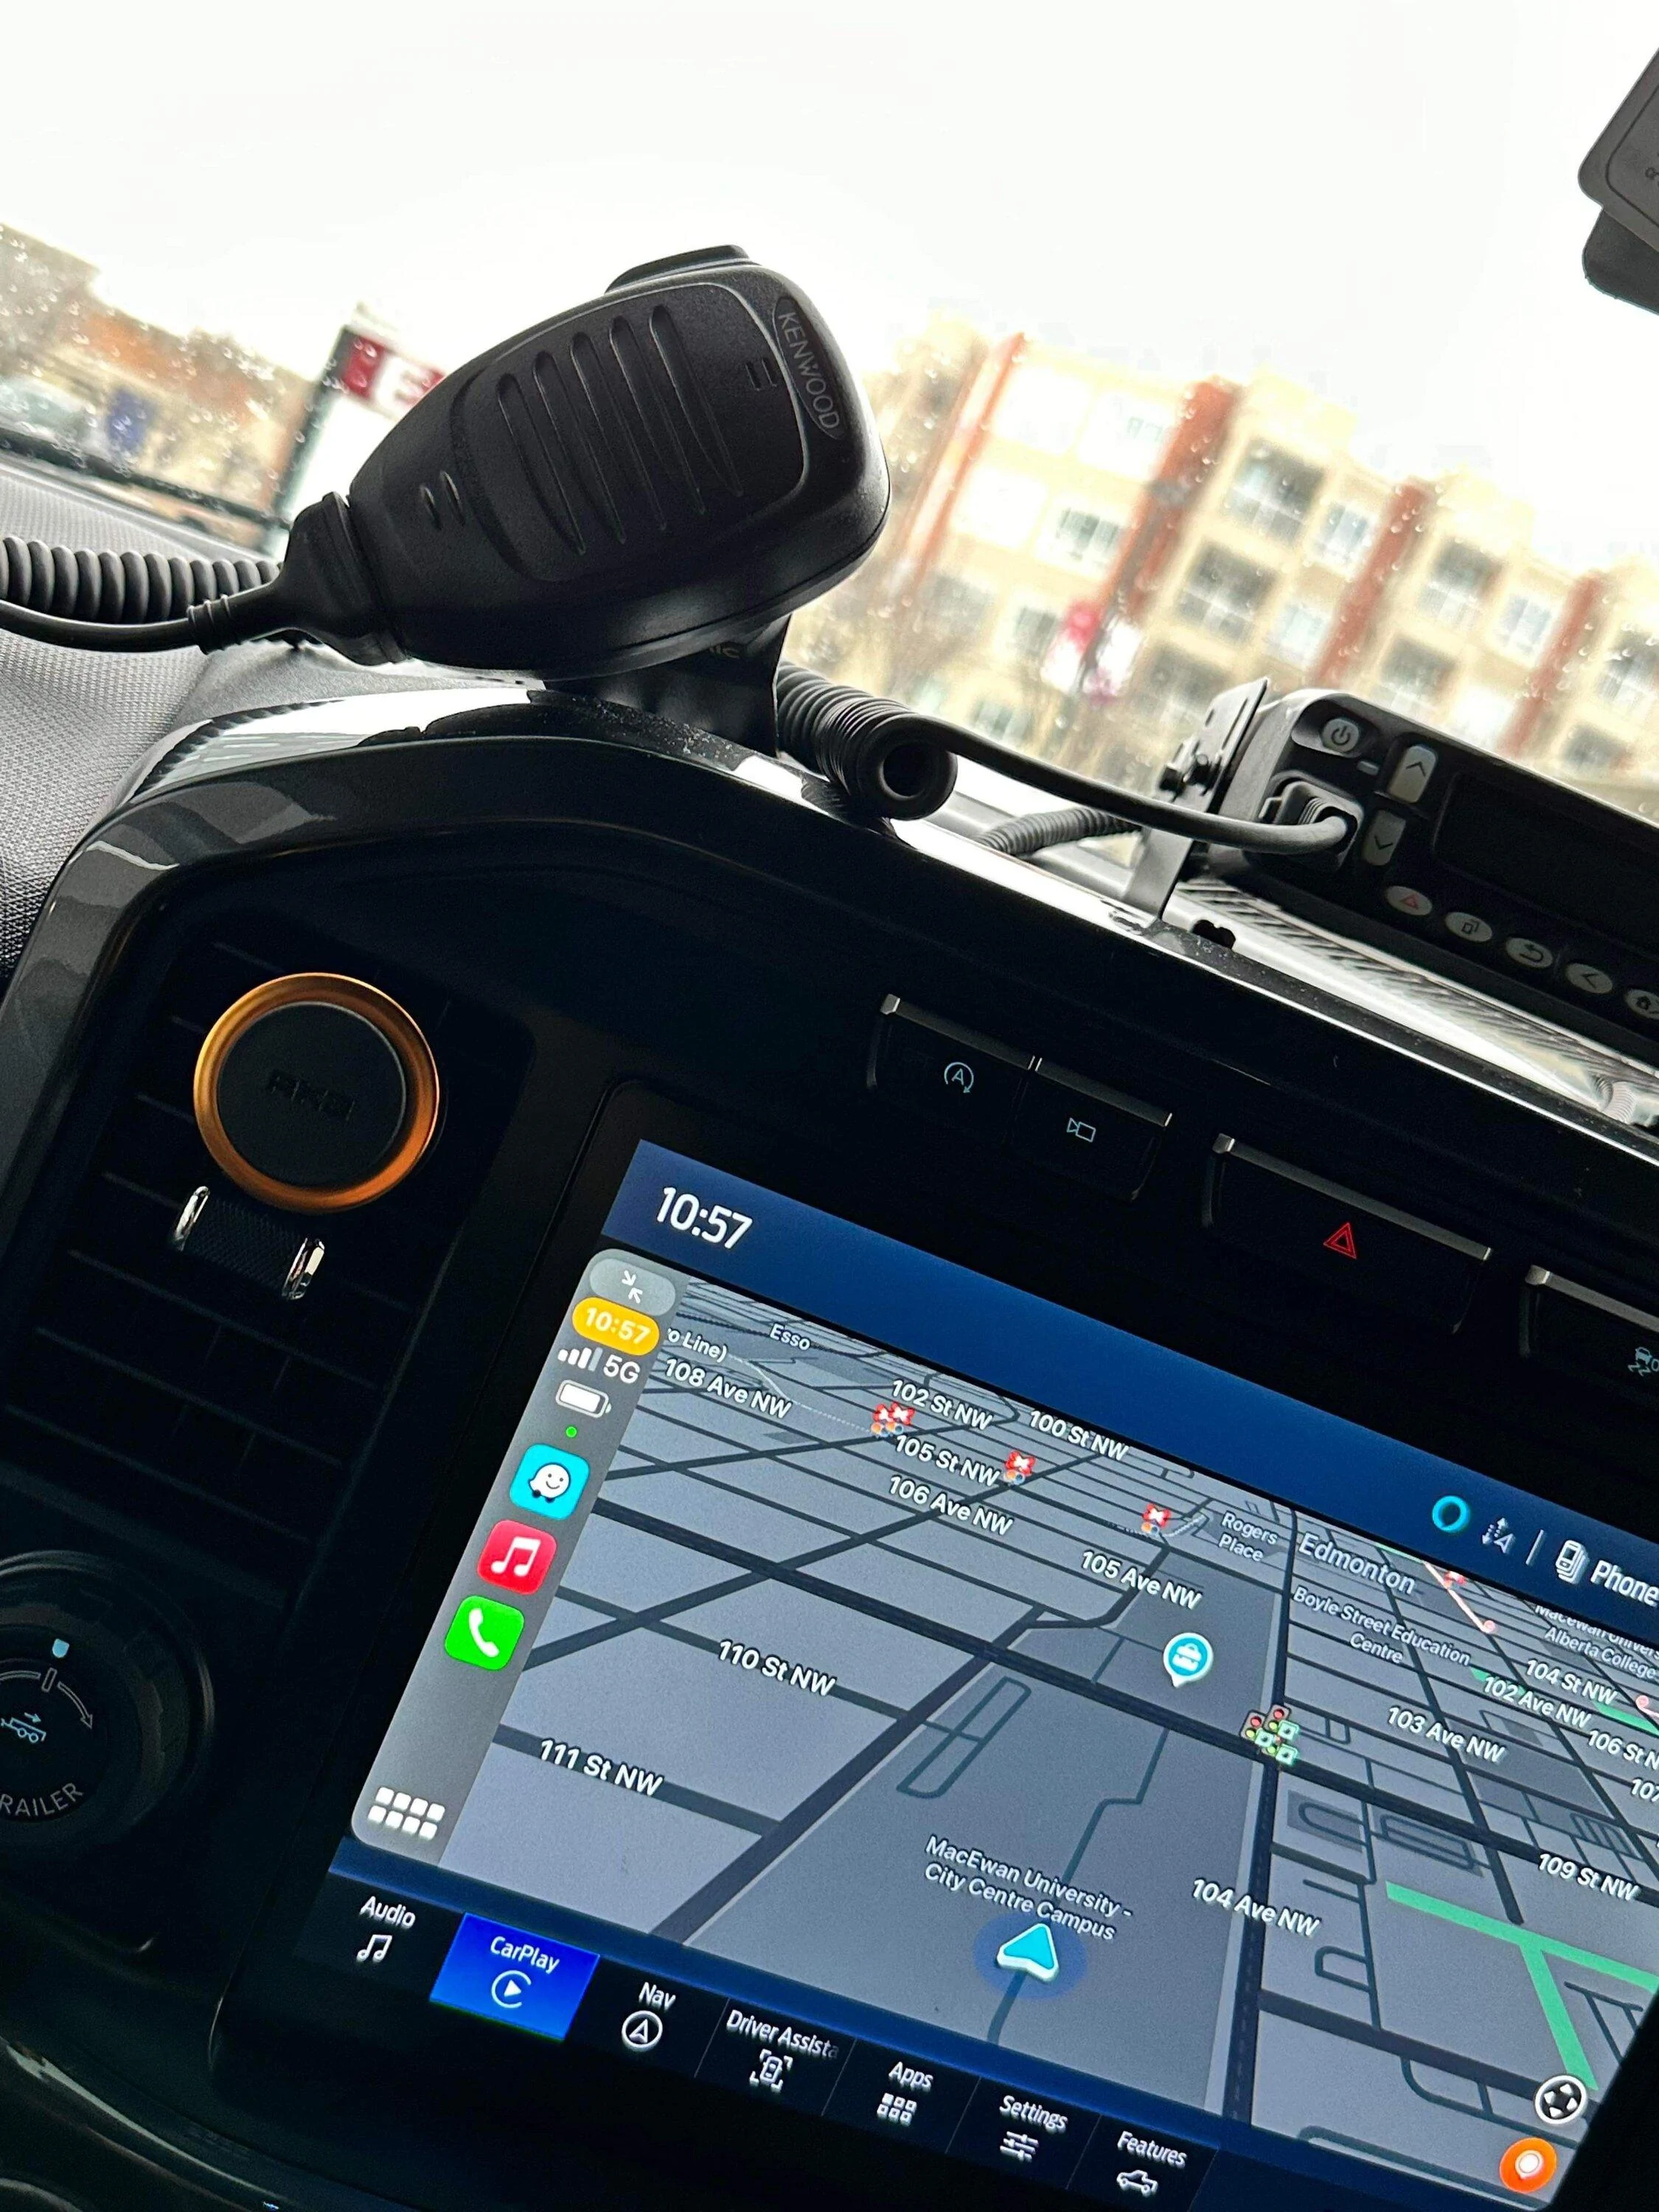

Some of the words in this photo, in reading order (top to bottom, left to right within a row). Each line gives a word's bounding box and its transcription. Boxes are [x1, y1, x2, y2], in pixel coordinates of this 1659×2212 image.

[777, 311, 841, 428] KENWOOD
[656, 1186, 753, 1249] 10:57
[585, 1307, 652, 1345] 10:57
[682, 1331, 727, 1363] Line)
[769, 1323, 811, 1351] Esso
[602, 1354, 641, 1384] 5G
[667, 1358, 706, 1388] 108
[706, 1375, 748, 1403] Ave
[751, 1390, 793, 1419] NW
[891, 1379, 928, 1405] 102
[931, 1394, 954, 1416] St
[956, 1402, 993, 1431] NW
[894, 1434, 933, 1464] 105
[935, 1450, 961, 1472] St
[962, 1460, 1000, 1487] NW
[1029, 1411, 1066, 1436] 100
[1068, 1425, 1092, 1447] St
[1092, 1433, 1129, 1462] NW
[888, 1475, 928, 1504] 106
[931, 1492, 970, 1520] Ave
[973, 1507, 1014, 1536] NW
[1220, 1511, 1279, 1547] Rogers
[1218, 1534, 1264, 1562] Place
[1298, 1532, 1416, 1595] Edmonton
[1082, 1551, 1121, 1579] 105
[1121, 1568, 1162, 1596] Ave
[1163, 1582, 1203, 1610] NW
[1590, 1559, 1659, 1607] Phone
[1293, 1587, 1340, 1615] Boyle
[1340, 1604, 1392, 1637] Street
[1391, 1624, 1472, 1667] Education
[1349, 1632, 1404, 1664] Centre
[719, 1640, 759, 1669] 110
[761, 1656, 788, 1682] St
[790, 1666, 837, 1697] NW
[1545, 1626, 1600, 1658] Alberta
[1601, 1647, 1656, 1679] College
[1484, 1675, 1519, 1703] 102
[1517, 1690, 1555, 1717] Ave
[1555, 1704, 1592, 1729] NW
[1526, 1659, 1561, 1686] 104
[1560, 1672, 1583, 1694] St
[1582, 1680, 1619, 1705] NW
[1388, 1707, 1424, 1735] 103
[1426, 1722, 1465, 1749] Ave
[1466, 1736, 1506, 1763] NW
[1587, 1729, 1623, 1756] 106
[1622, 1743, 1645, 1764] St
[540, 1740, 580, 1770] 111
[583, 1756, 611, 1780] St
[614, 1765, 664, 1796] NW
[925, 1835, 1021, 1882] MacEwan
[1023, 1868, 1121, 1919] University
[925, 1863, 966, 1892] City
[967, 1877, 1034, 1913] Centre
[1036, 1901, 1116, 1941] Campus
[1539, 1853, 1576, 1879] 109
[1577, 1868, 1600, 1889] St
[1600, 1875, 1641, 1902] NW
[359, 1896, 416, 1930] Audio
[1192, 1878, 1230, 1907] 104
[1234, 1893, 1276, 1922] Ave
[1278, 1908, 1321, 1937] NW
[490, 1935, 560, 1975] CarPlay
[639, 1982, 676, 2010] Nav
[726, 2009, 779, 2043] Driver
[777, 2026, 840, 2059] Assista
[888, 2062, 933, 2093] Apps
[999, 2095, 1068, 2133] Settings
[1117, 2131, 1187, 2168] Features
